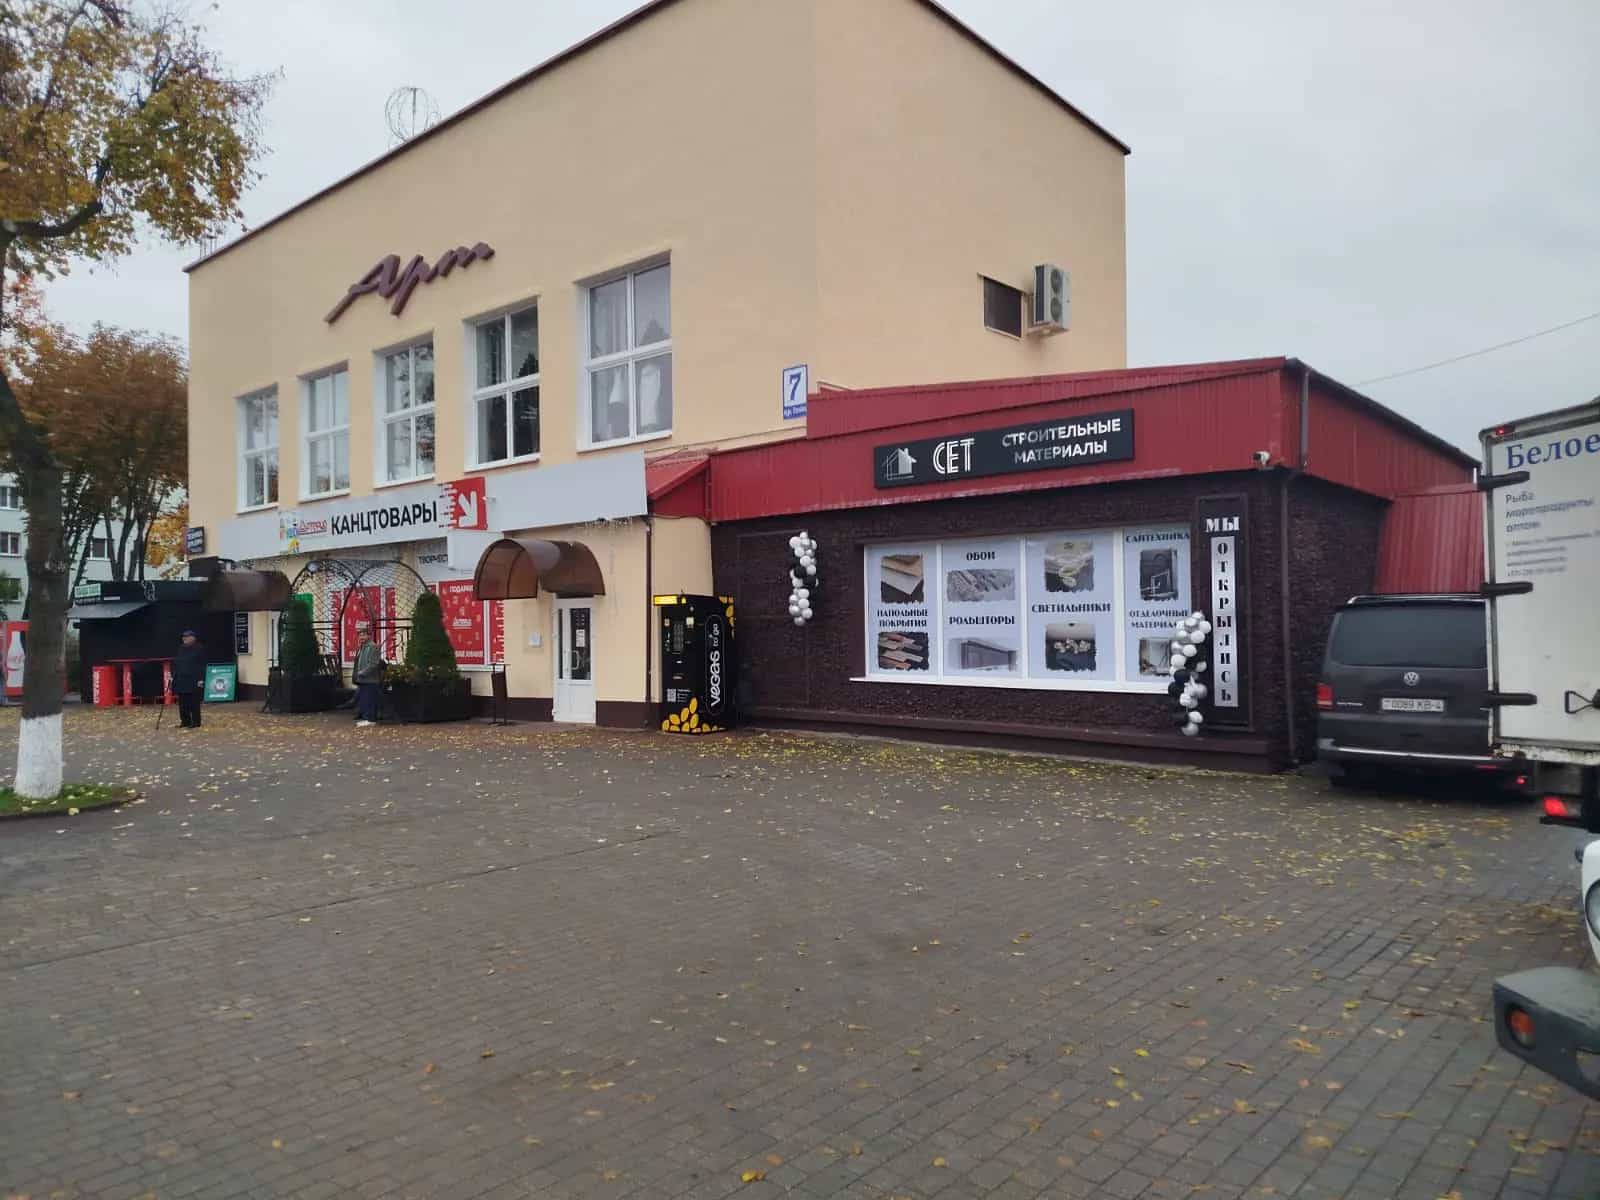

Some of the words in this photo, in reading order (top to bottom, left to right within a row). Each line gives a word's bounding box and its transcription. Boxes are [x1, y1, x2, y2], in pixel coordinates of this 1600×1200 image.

[323, 242, 495, 325] Арт
[790, 371, 801, 400] 7
[1002, 418, 1121, 447] СТРОИТЕЛЬНЫЕ
[933, 438, 975, 475] СЕТ
[1014, 440, 1107, 464] МАТЕРИАЛЫ
[1506, 433, 1600, 470] Белое
[331, 501, 437, 535] КАНЦТОВАРЫ
[1205, 517, 1240, 532] МЫ
[966, 551, 995, 561] ОБОИ
[949, 615, 1015, 626] РОЛЬШТОРЫ
[1031, 602, 1111, 613] СВЕТИЛЬНИКИ
[1217, 542, 1232, 702] ОТКРЫЛИСЬ
[879, 619, 927, 628] ПОКРЫТИЯ
